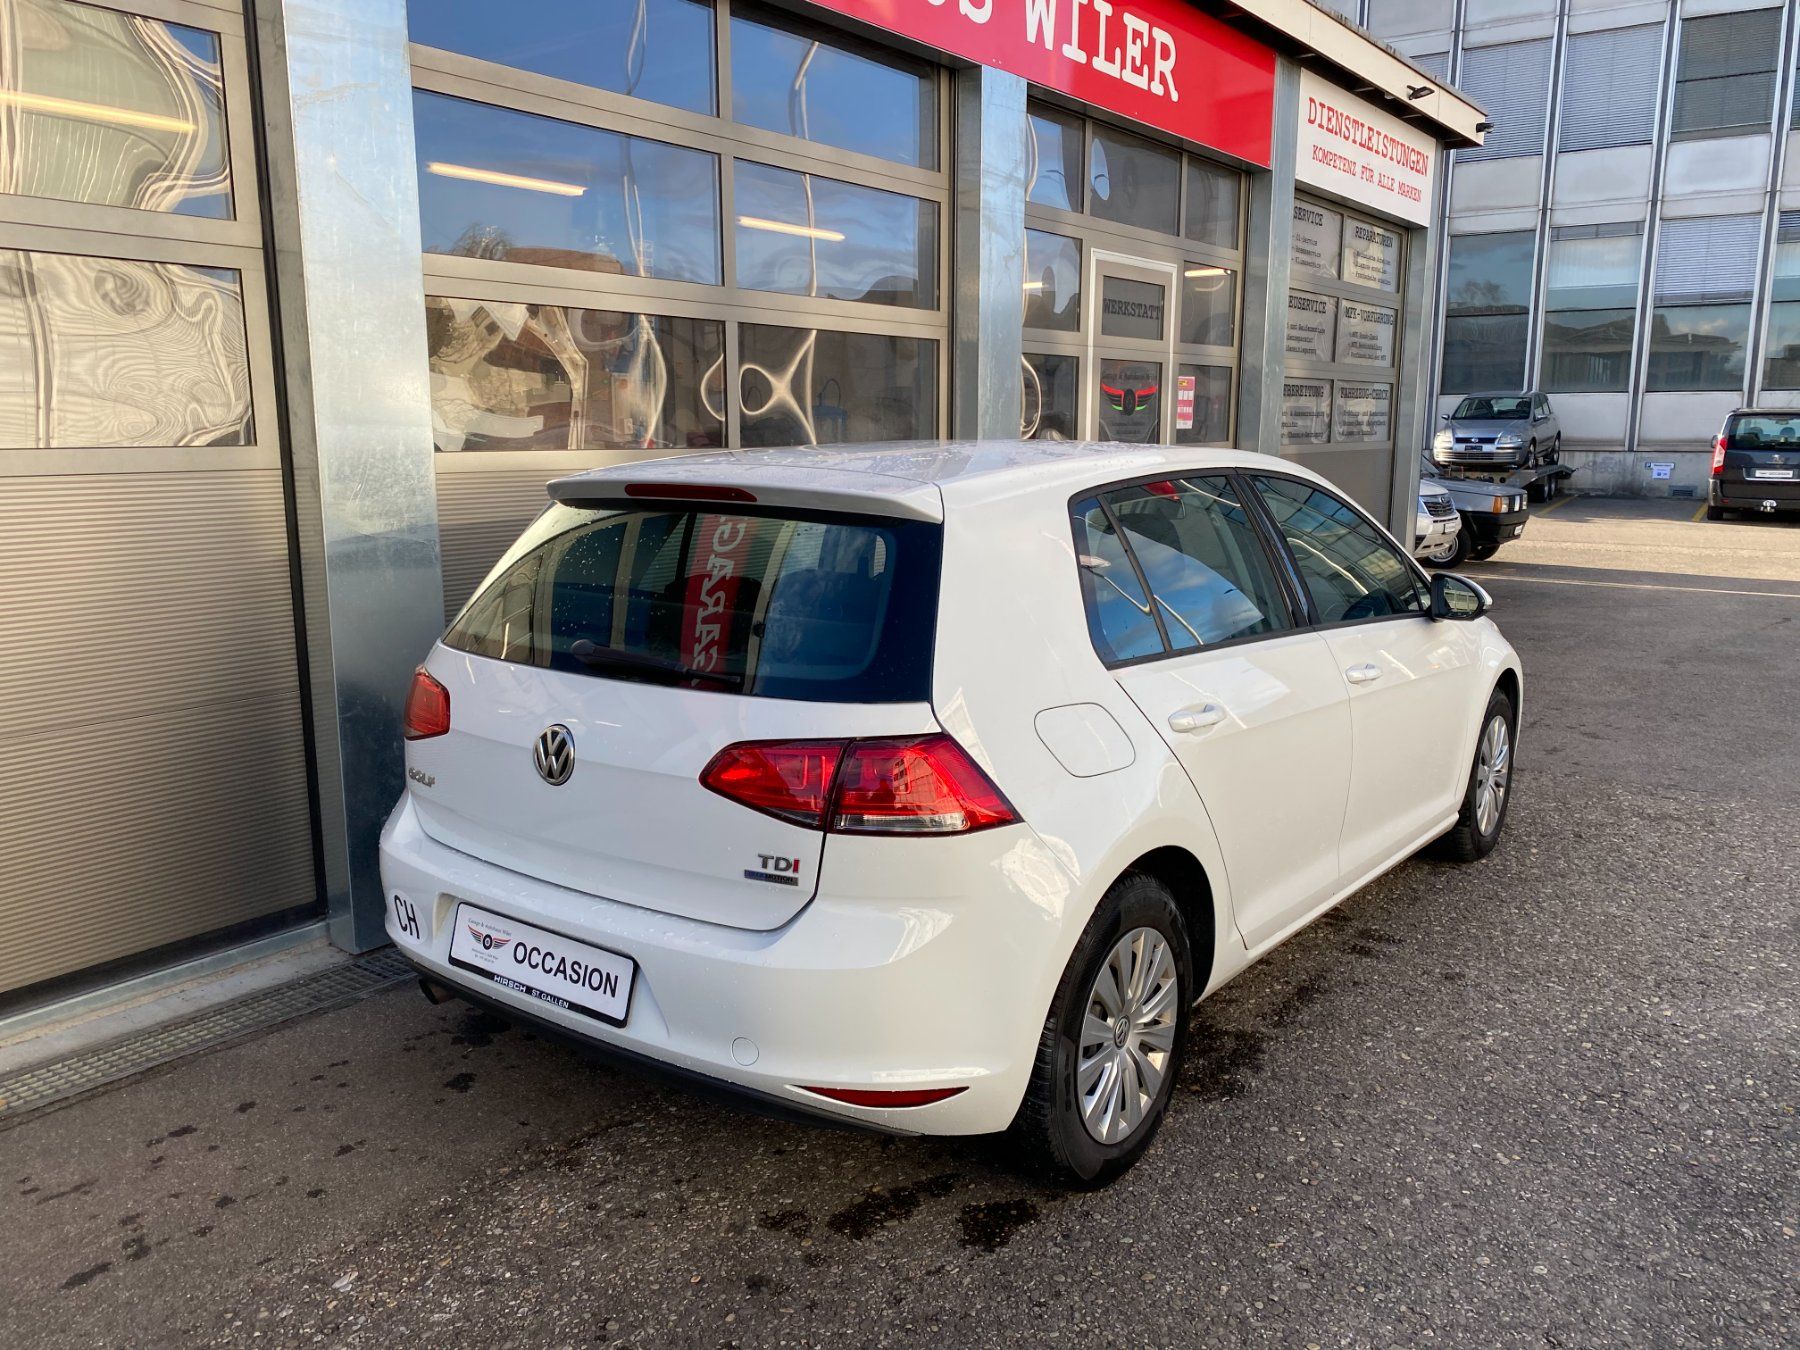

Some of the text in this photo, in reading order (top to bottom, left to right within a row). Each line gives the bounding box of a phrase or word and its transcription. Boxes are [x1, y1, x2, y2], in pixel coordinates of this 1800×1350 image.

[1024, 0, 1179, 102] WILER
[1307, 97, 1429, 177] DIENSTLEISTUNGEN
[1312, 144, 1422, 202] KOMPETENZ FÜR ALLE MARKEN
[1294, 206, 1323, 227] SERVICE
[1355, 225, 1393, 248] REPARATUREN
[1103, 297, 1160, 320] WERKSTATT
[758, 853, 800, 874] TDI
[393, 894, 420, 940] CH
[513, 941, 619, 998] OCCASION
[493, 974, 527, 993] HIRSCH
[541, 992, 569, 1009] GALLEN
